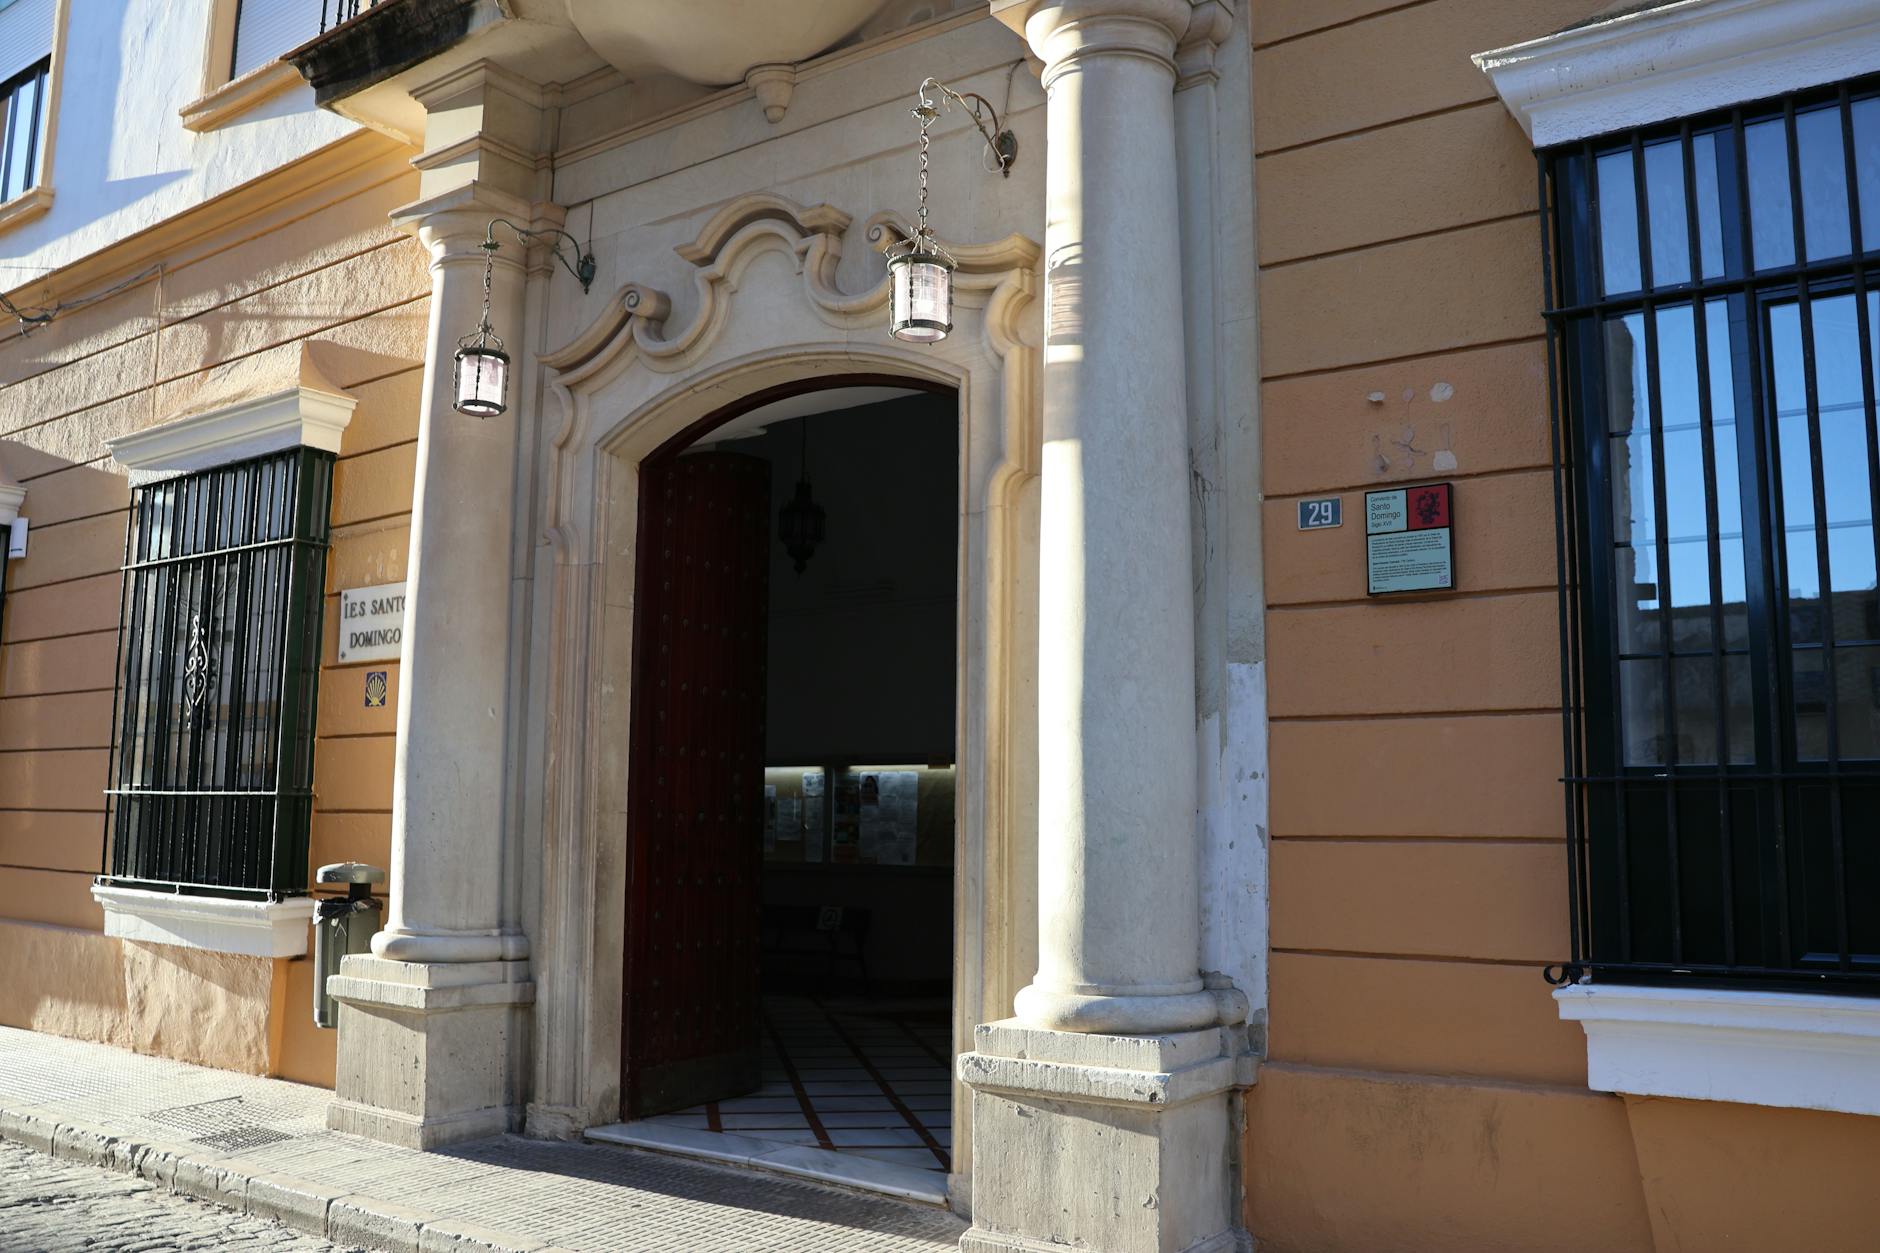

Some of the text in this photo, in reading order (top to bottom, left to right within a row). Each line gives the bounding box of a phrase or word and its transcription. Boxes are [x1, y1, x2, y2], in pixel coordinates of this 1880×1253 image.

[1308, 502, 1333, 525] 29
[1370, 503, 1391, 511] Santo
[1371, 511, 1400, 520] Domingo
[350, 627, 401, 649] DOMINGO
